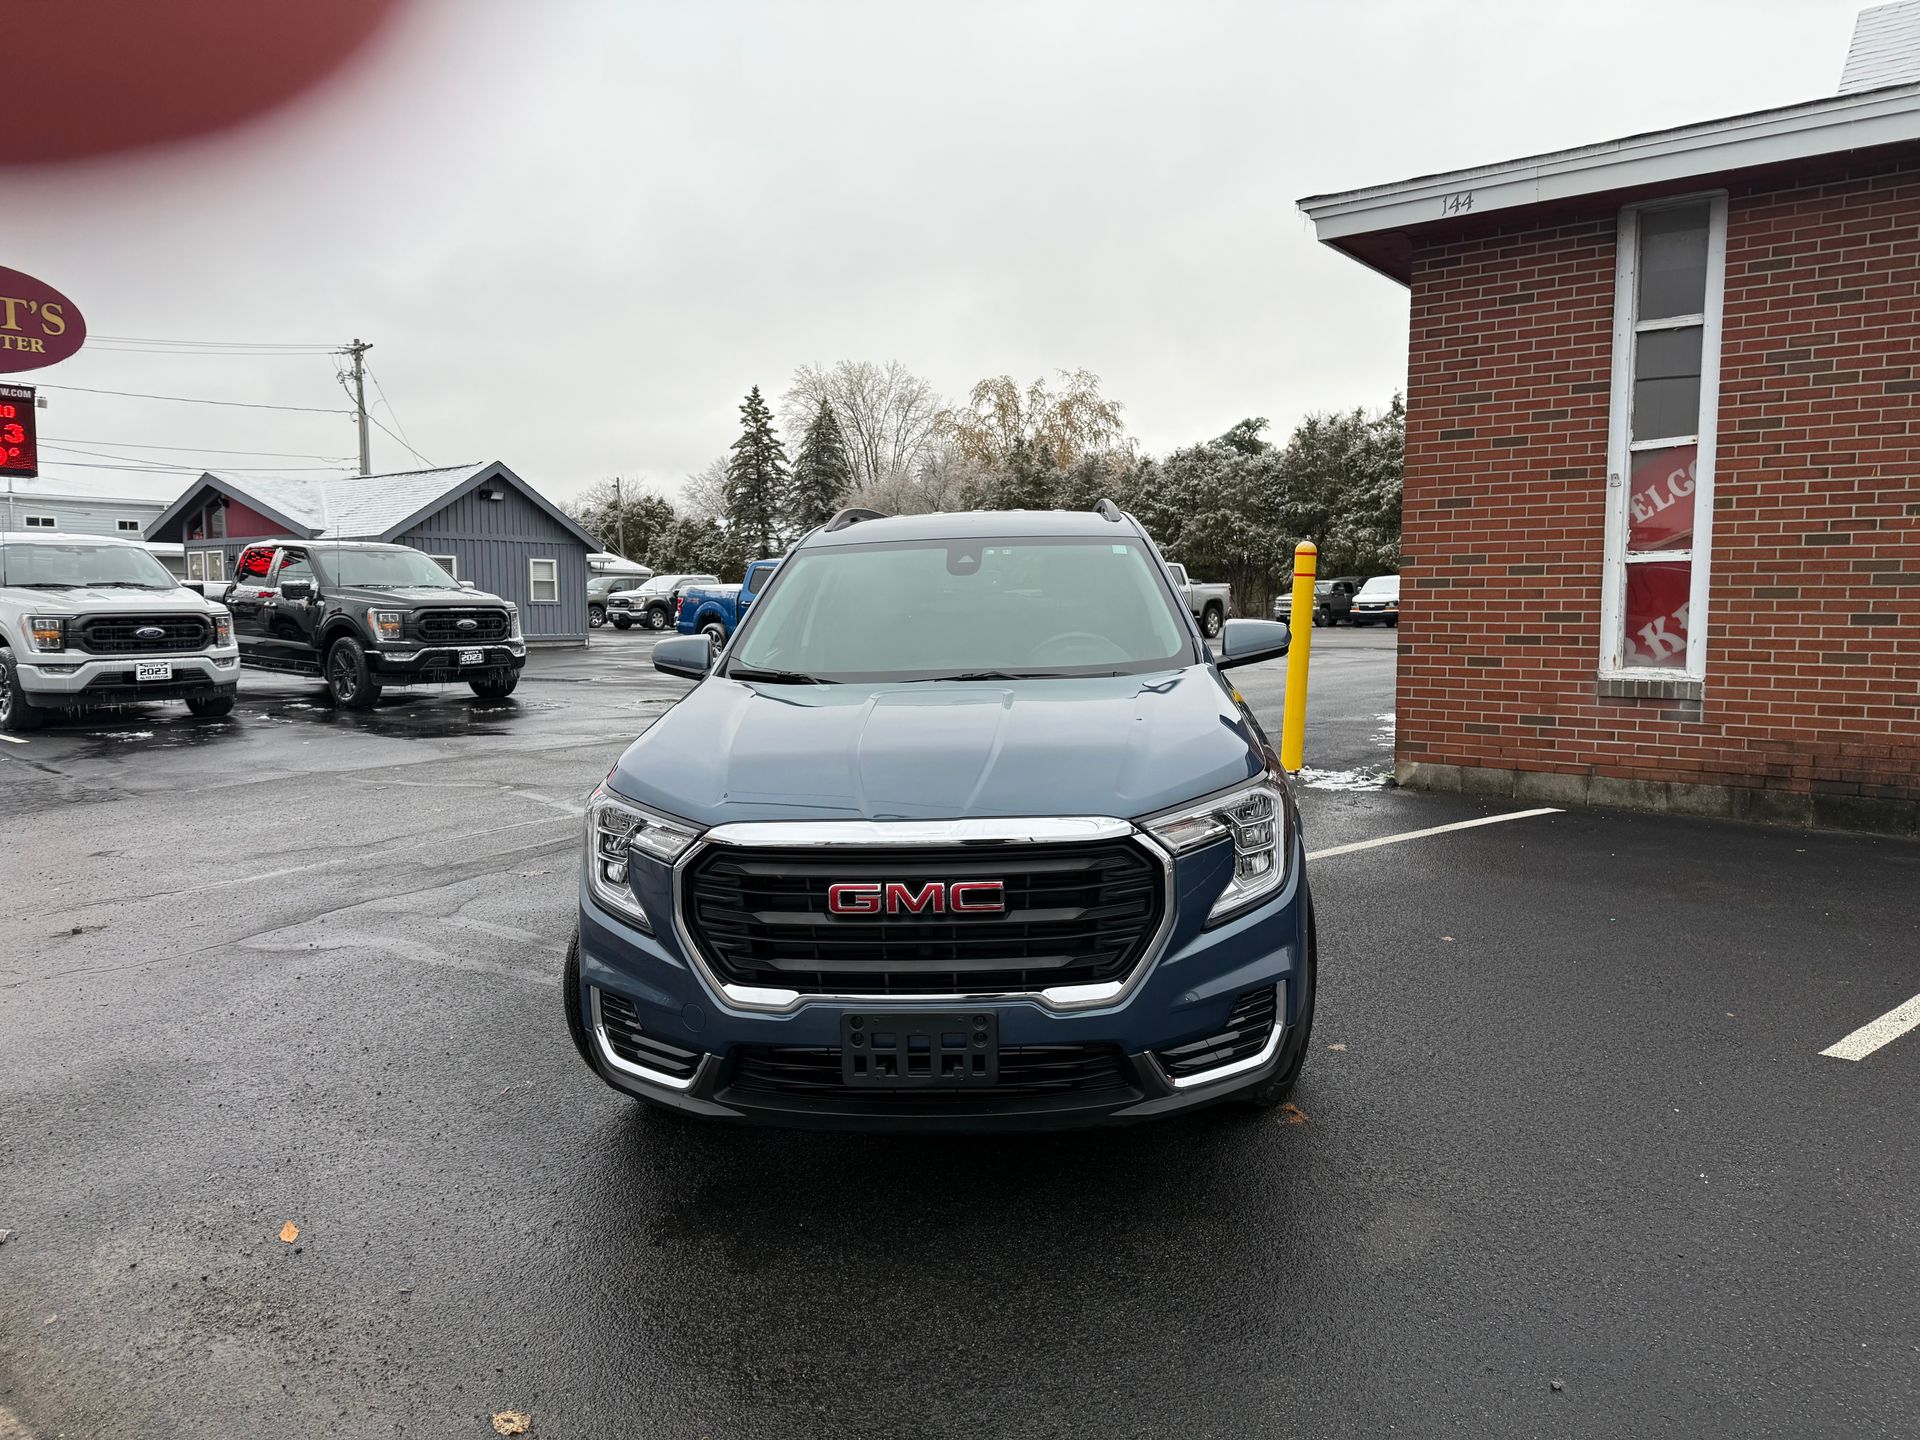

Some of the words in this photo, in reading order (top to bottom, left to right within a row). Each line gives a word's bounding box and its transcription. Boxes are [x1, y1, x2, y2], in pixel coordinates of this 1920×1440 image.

[1441, 191, 1474, 217] 144
[139, 667, 168, 676] 2023
[828, 881, 1006, 914] GMC
